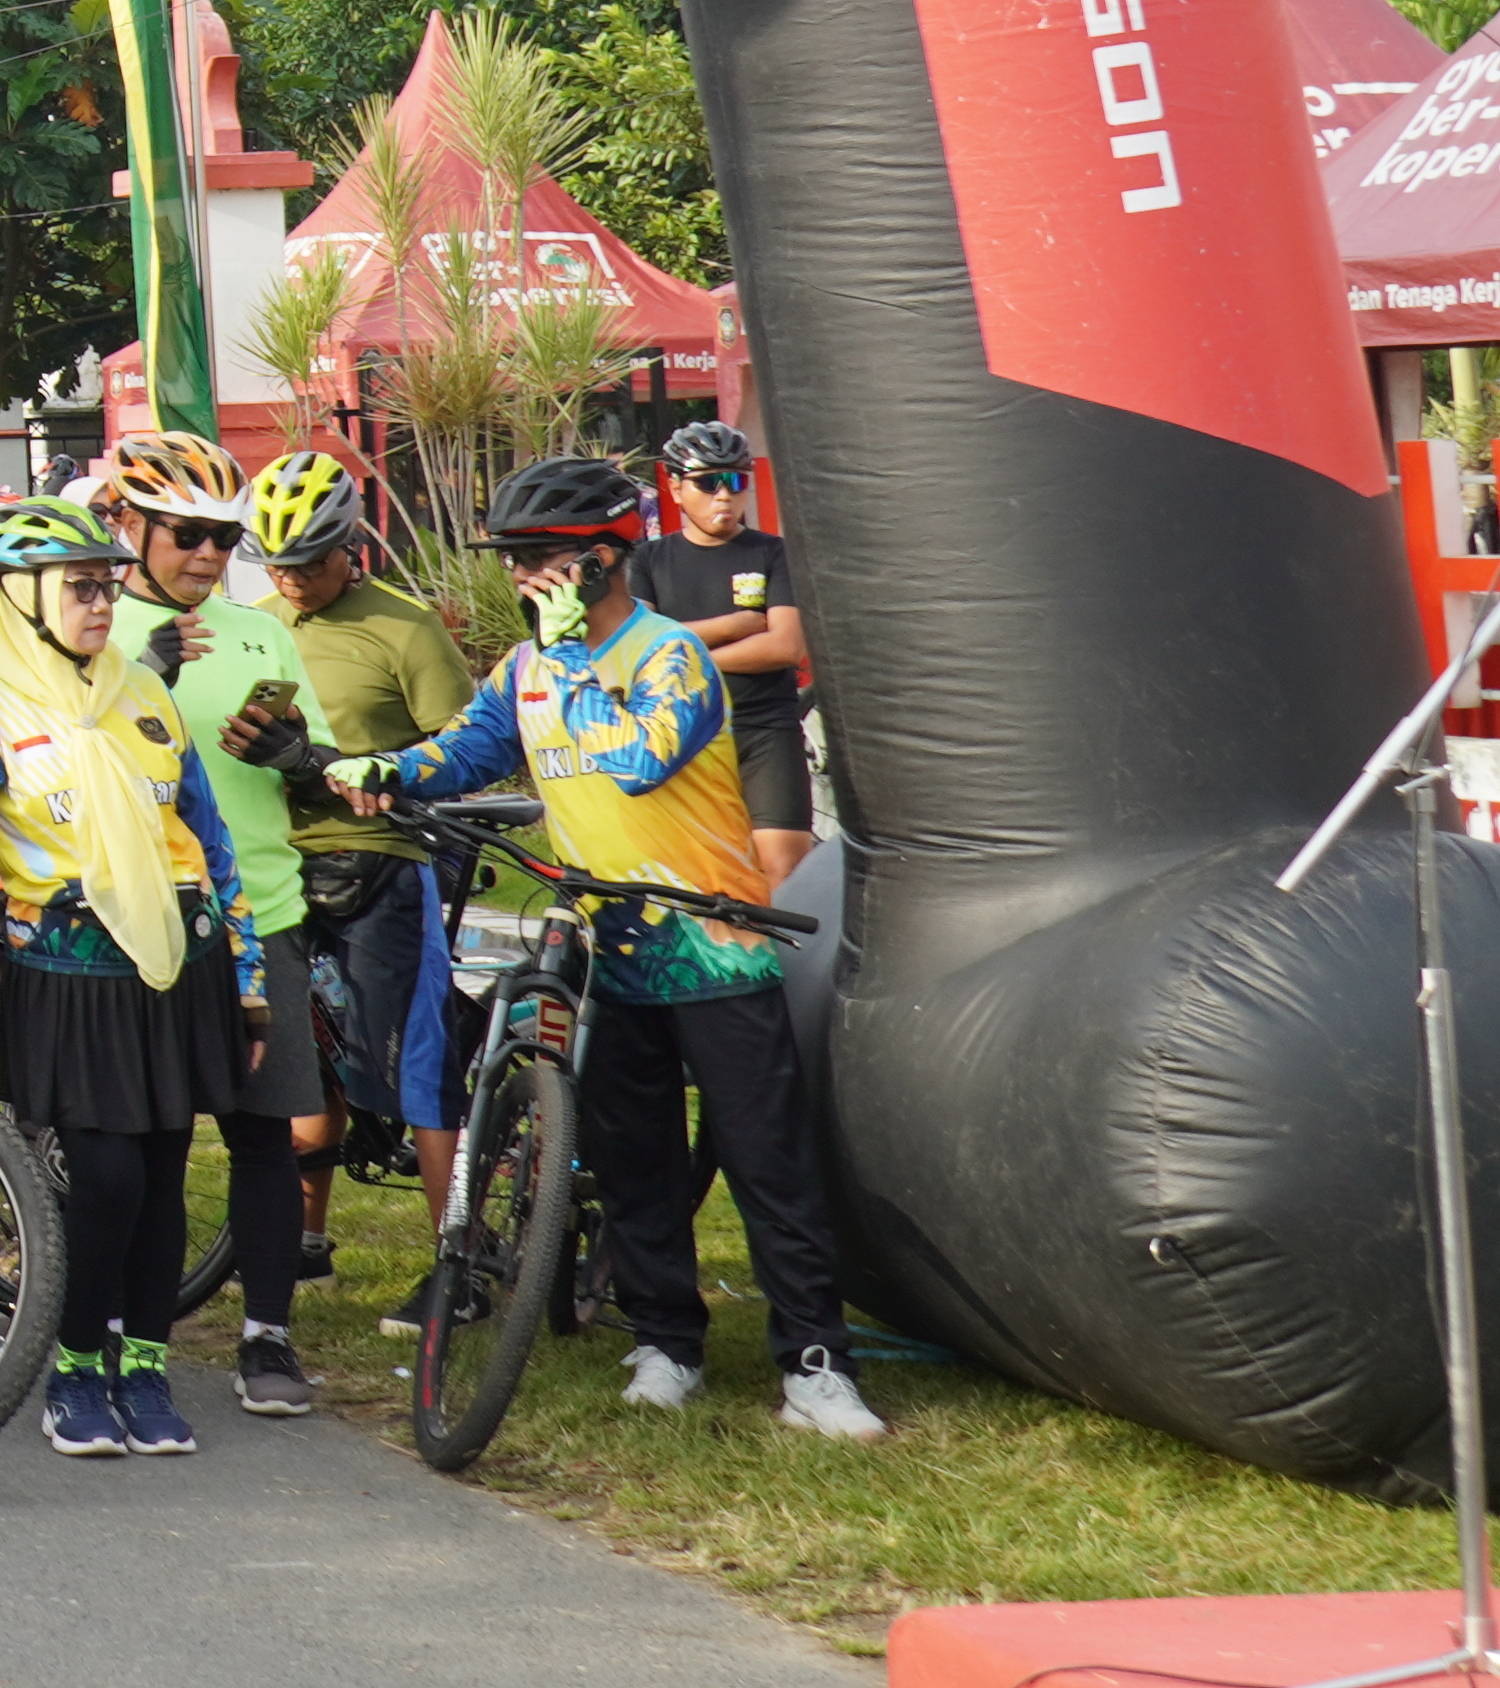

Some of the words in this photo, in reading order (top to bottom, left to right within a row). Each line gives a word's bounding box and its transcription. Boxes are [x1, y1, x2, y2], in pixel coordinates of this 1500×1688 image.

[1360, 142, 1500, 192] koper
[1385, 283, 1458, 312] Tenaga
[1460, 272, 1500, 308] Kerj
[673, 351, 717, 372] Kerja
